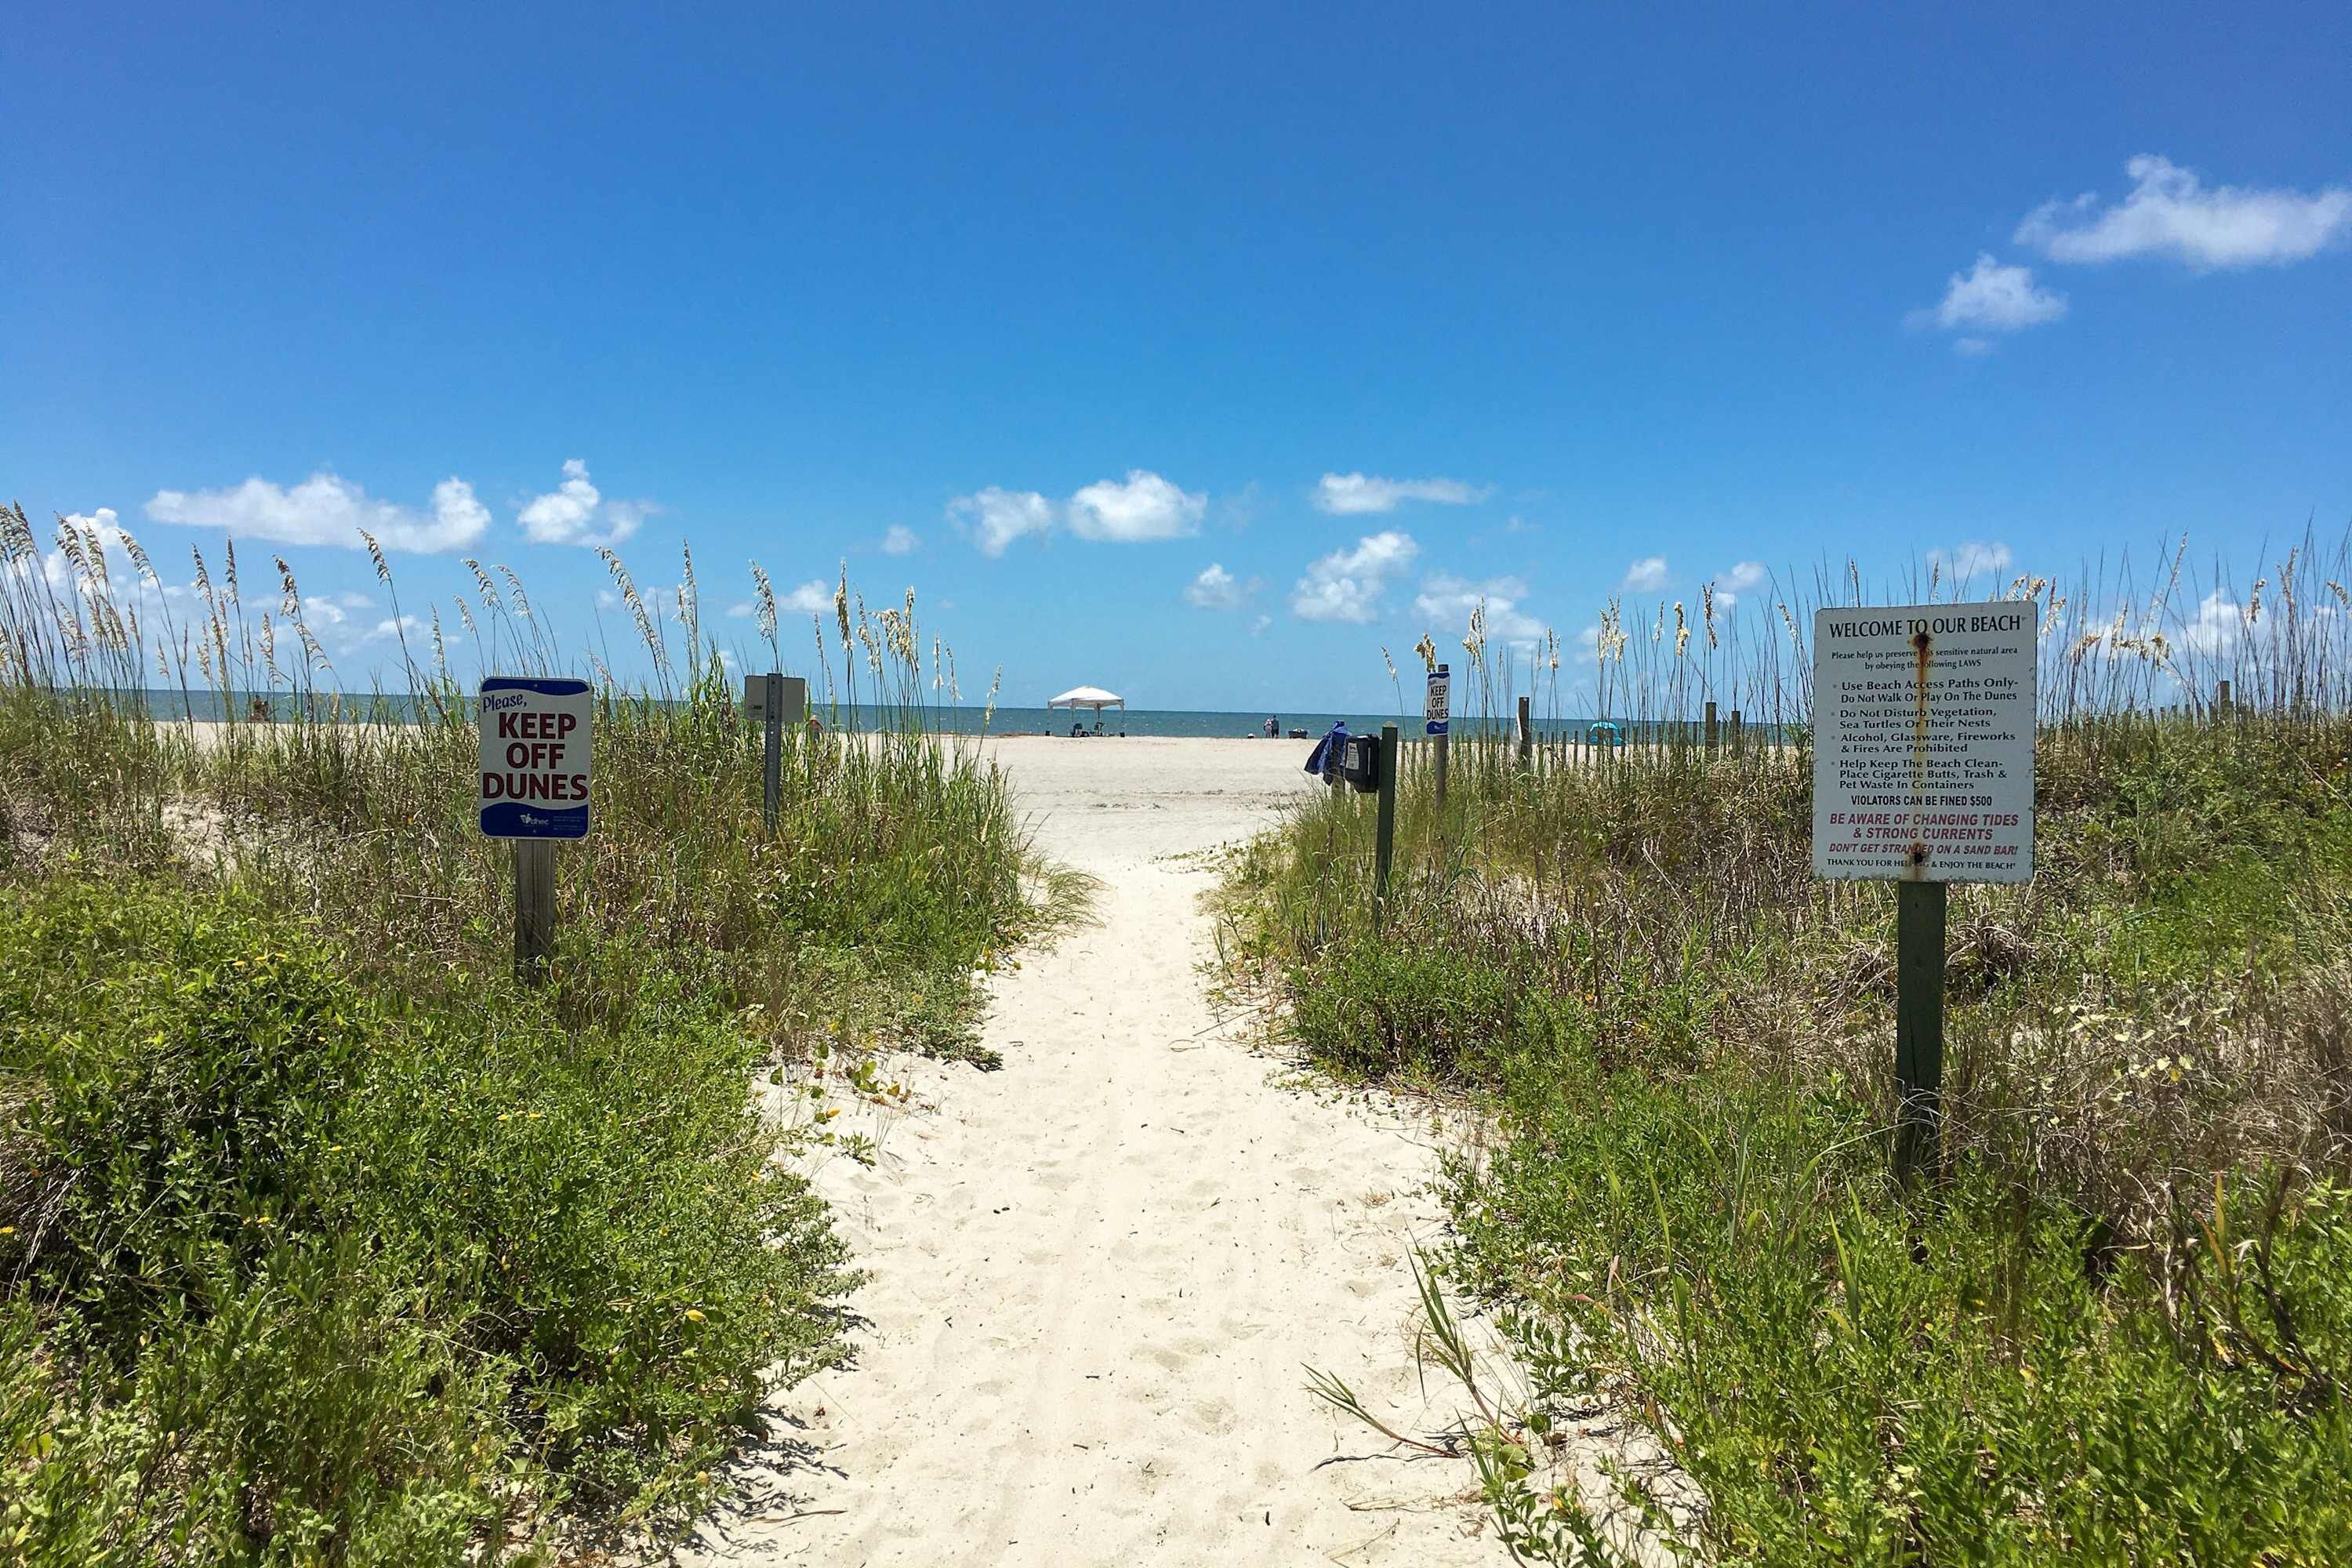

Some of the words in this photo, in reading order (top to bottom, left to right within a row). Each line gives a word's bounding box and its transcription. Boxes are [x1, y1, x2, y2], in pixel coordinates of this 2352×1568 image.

[1830, 620, 1902, 638] WELCOME
[1907, 619, 1928, 635] TO
[1933, 617, 1965, 633] OUR
[1972, 615, 2020, 633] BEACH
[1857, 651, 1873, 661] help
[1886, 651, 1918, 660] preserve
[1936, 648, 1969, 656] sensitive
[1971, 646, 1999, 655] natural
[1876, 660, 1905, 670] obeying
[1921, 659, 1957, 670] ollowing
[1842, 681, 1863, 691] Use
[1867, 680, 1901, 690] Beach
[1905, 679, 1944, 689] Access
[1948, 678, 1980, 688] Paths
[1984, 677, 2019, 689] Only-
[1430, 685, 1447, 696] KEEP
[483, 694, 527, 713] Please,
[1432, 697, 1444, 708] OFF
[1841, 694, 1854, 703] Do
[1857, 694, 1875, 703] Not
[1878, 693, 1901, 702] Walk
[1905, 693, 1917, 702] Or
[1921, 692, 1940, 704] Play
[1944, 692, 1959, 701] On
[1962, 691, 1981, 701] The
[1984, 691, 2017, 701] Dunes
[1427, 709, 1449, 720] DUNES
[1859, 709, 1879, 717] Not
[1884, 707, 1926, 717] Disturb
[1931, 707, 1997, 720] Vegetation,
[499, 712, 577, 739] KEEP
[1862, 720, 1901, 728] Turtles
[1923, 719, 1955, 728] Their
[1958, 719, 1991, 728] Nests
[1841, 733, 1886, 742] Alcohol,
[1891, 733, 1954, 742] Glassware,
[1958, 732, 2016, 741] Fireworks
[1907, 744, 1968, 753] Prohibited
[506, 742, 564, 769] OFF
[1840, 760, 1866, 770] Help
[1870, 760, 1898, 770] Keep
[1902, 759, 1922, 768] The
[1926, 758, 1961, 768] Beach
[1965, 759, 2002, 768] Clean-
[1840, 770, 1868, 779] Place
[1873, 770, 1923, 781] Cigarette
[1928, 770, 1959, 779] Butts,
[1964, 770, 1994, 779] Trash
[482, 772, 588, 800] DUNES
[1912, 780, 1974, 789] Containers
[1851, 795, 1900, 806] VIOLATORS
[1904, 795, 1922, 806] CAN
[1926, 795, 1937, 806] BE
[1940, 795, 1967, 806] FINED
[1970, 795, 1992, 808] $500
[1830, 813, 1845, 824] BE
[1848, 813, 1890, 824] AWARE
[1894, 814, 1909, 825] OF
[1913, 814, 1978, 826] CHANGING
[1983, 815, 2019, 826] TIDES
[1853, 828, 1861, 838] &
[1866, 828, 1918, 839] STRONG
[1922, 828, 1993, 840] CURRENTS
[1829, 844, 1858, 853] DON'T
[1860, 844, 1880, 853] GET
[1936, 844, 1951, 855] ON
[1953, 845, 1961, 855] A
[1963, 845, 1991, 855] SAND
[1994, 845, 2019, 855] BAR!
